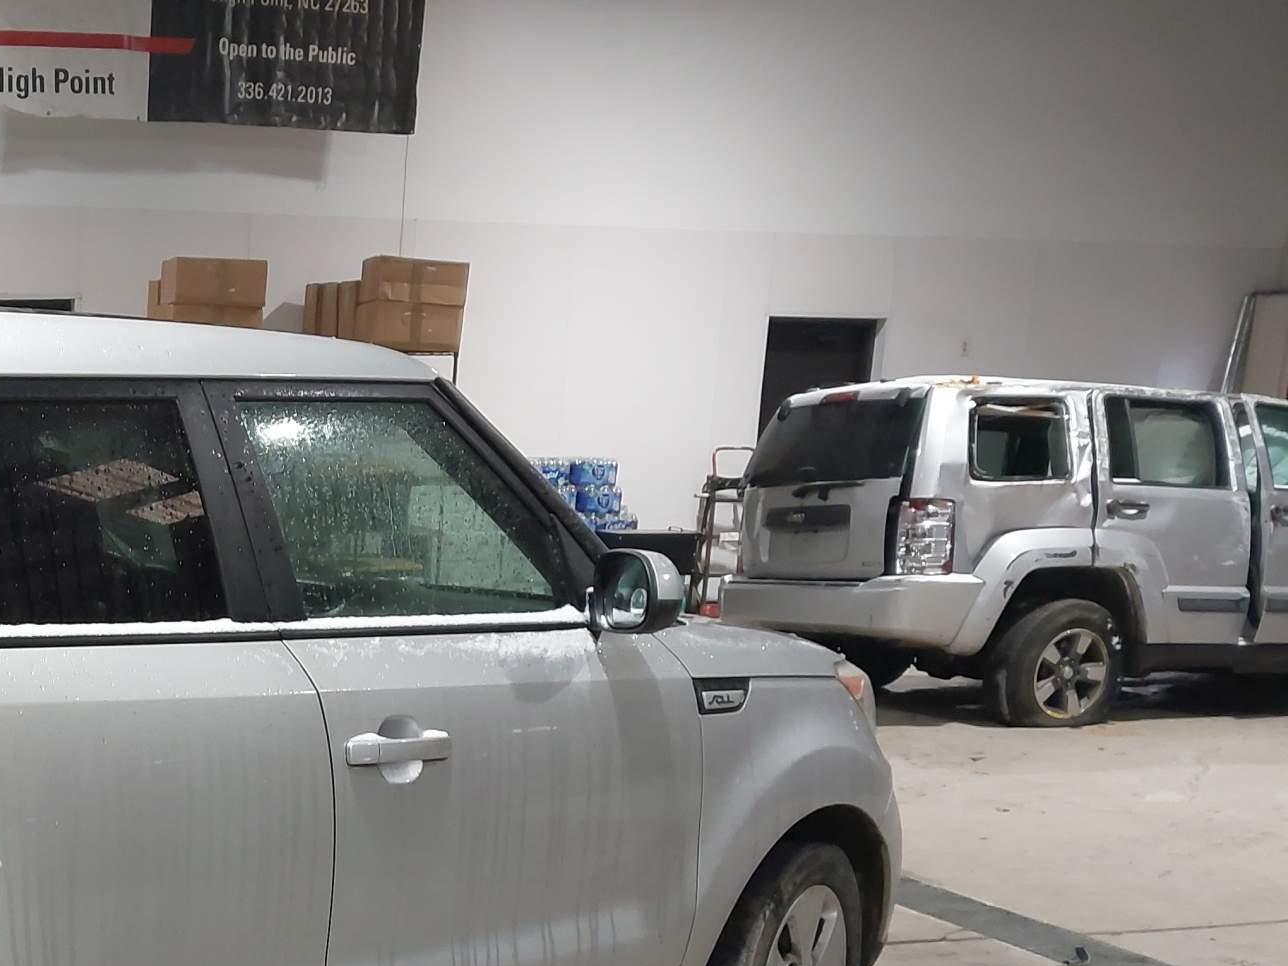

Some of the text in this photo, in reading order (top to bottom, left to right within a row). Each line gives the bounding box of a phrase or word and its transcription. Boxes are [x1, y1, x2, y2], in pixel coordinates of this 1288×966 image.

[324, 0, 369, 14] 27263
[219, 37, 356, 65] Open to the Public
[55, 68, 115, 95] Point
[238, 81, 333, 105] 336.421.2013
